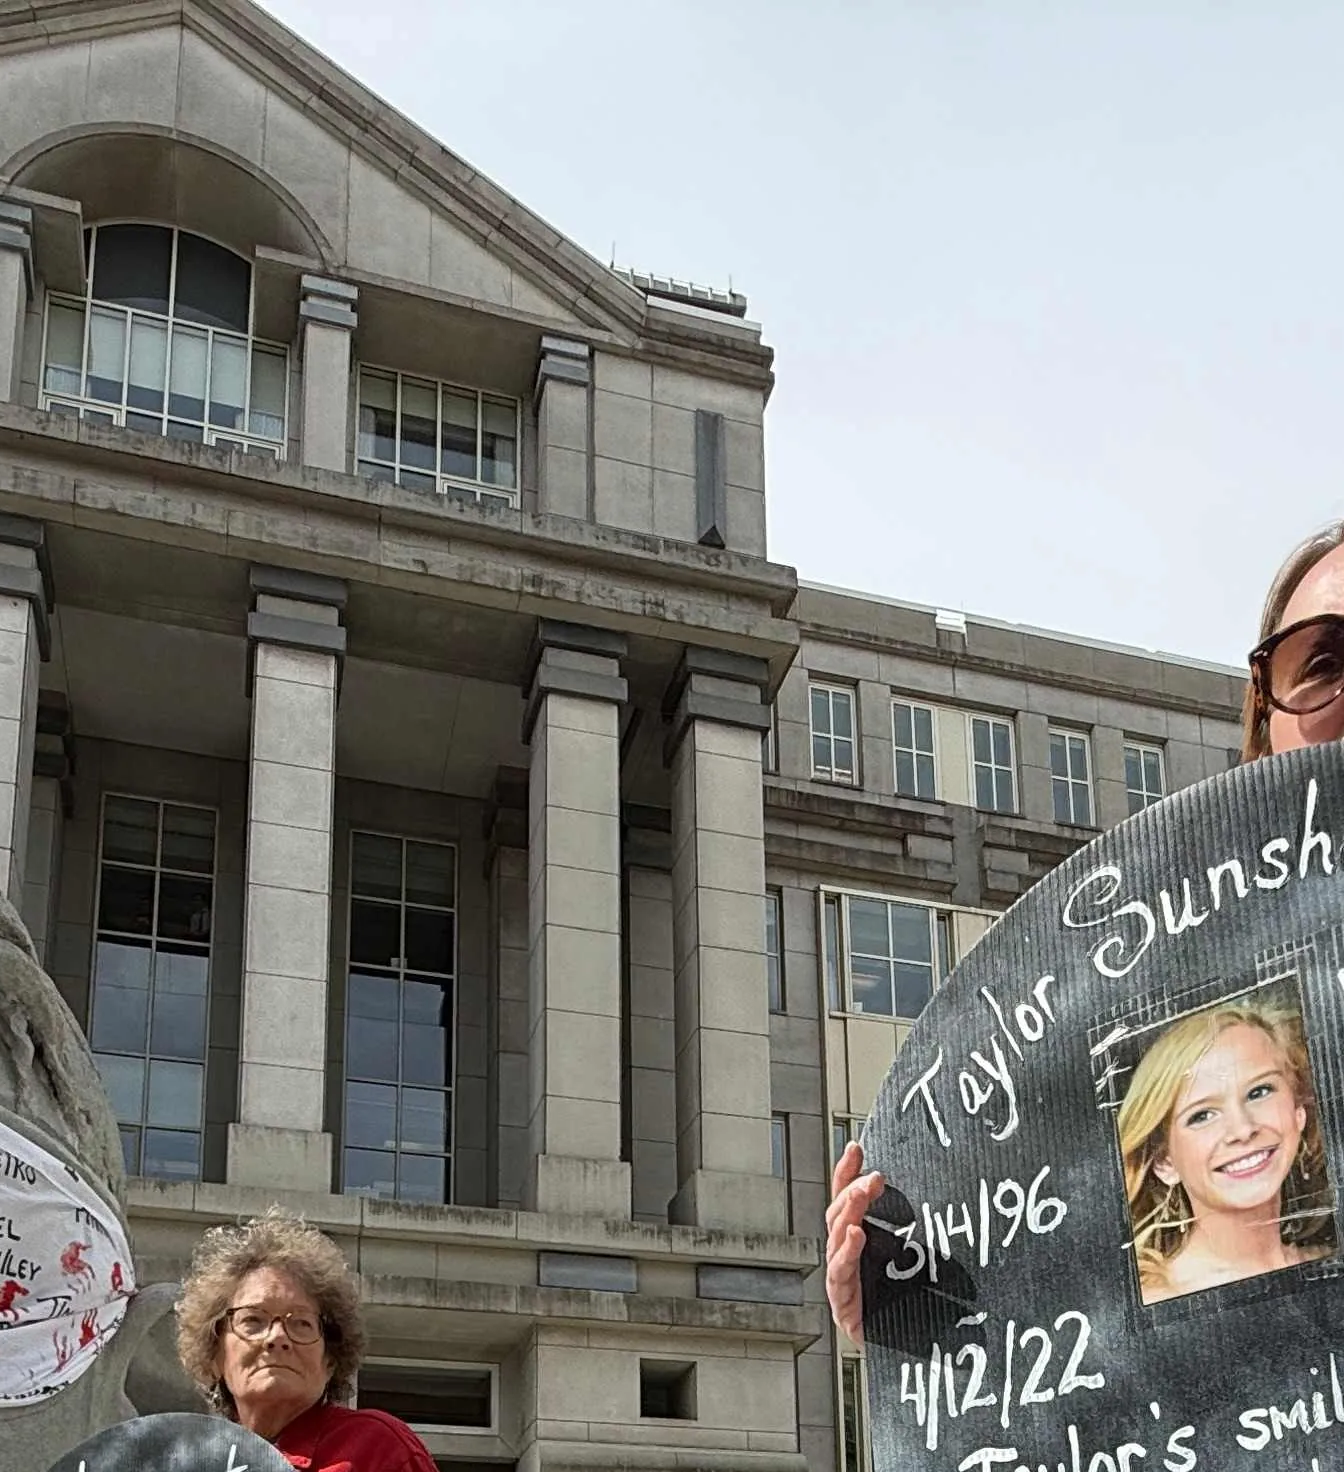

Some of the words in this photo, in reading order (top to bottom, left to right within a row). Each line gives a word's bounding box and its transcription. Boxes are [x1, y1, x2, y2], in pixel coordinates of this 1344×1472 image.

[901, 974, 1058, 1149] Taylor
[886, 1166, 1067, 1283] 3/14/96
[900, 1310, 1105, 1451] 4/12/22
